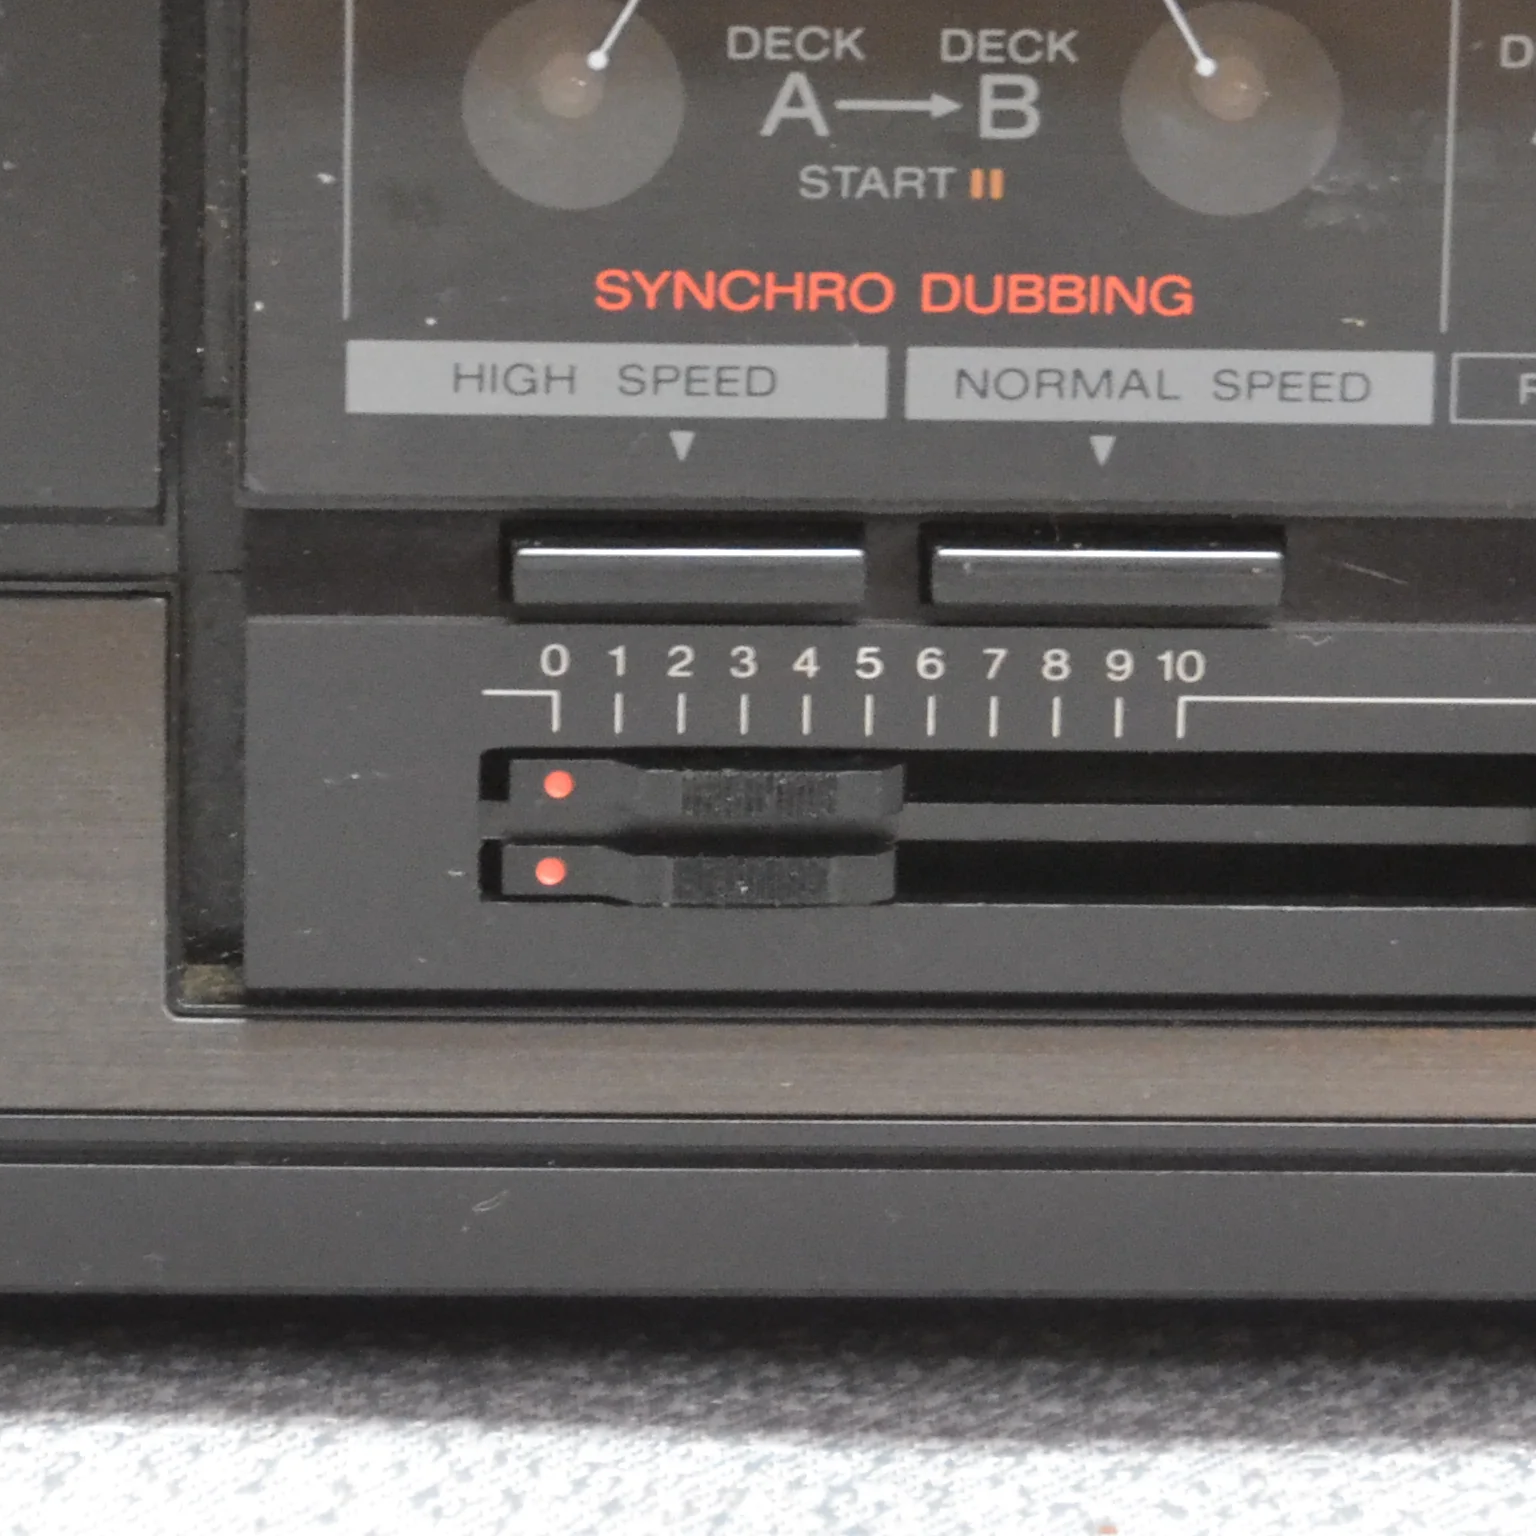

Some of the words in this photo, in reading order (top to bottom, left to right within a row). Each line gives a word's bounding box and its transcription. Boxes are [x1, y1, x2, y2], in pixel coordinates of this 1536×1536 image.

[726, 26, 865, 61] DECK
[940, 28, 1079, 64] DECK
[760, 71, 830, 137] A
[979, 73, 1041, 140] B
[798, 165, 956, 200] START
[594, 268, 896, 314] SYNCHRO
[920, 272, 1195, 316] DUBBING
[452, 362, 577, 396] HIGH
[618, 364, 777, 397] SPEED
[955, 367, 1181, 400] NORMAL
[1212, 369, 1372, 403] SPEED
[540, 644, 570, 676] 0
[608, 646, 627, 676] 1
[667, 645, 695, 677] 2
[729, 646, 758, 677] 3
[792, 647, 821, 678] 4
[855, 647, 884, 679] 5
[916, 647, 946, 680] 6
[983, 649, 1008, 680] 7
[1041, 649, 1071, 681] 8
[1105, 650, 1134, 682] 9
[1157, 650, 1206, 683] 10
